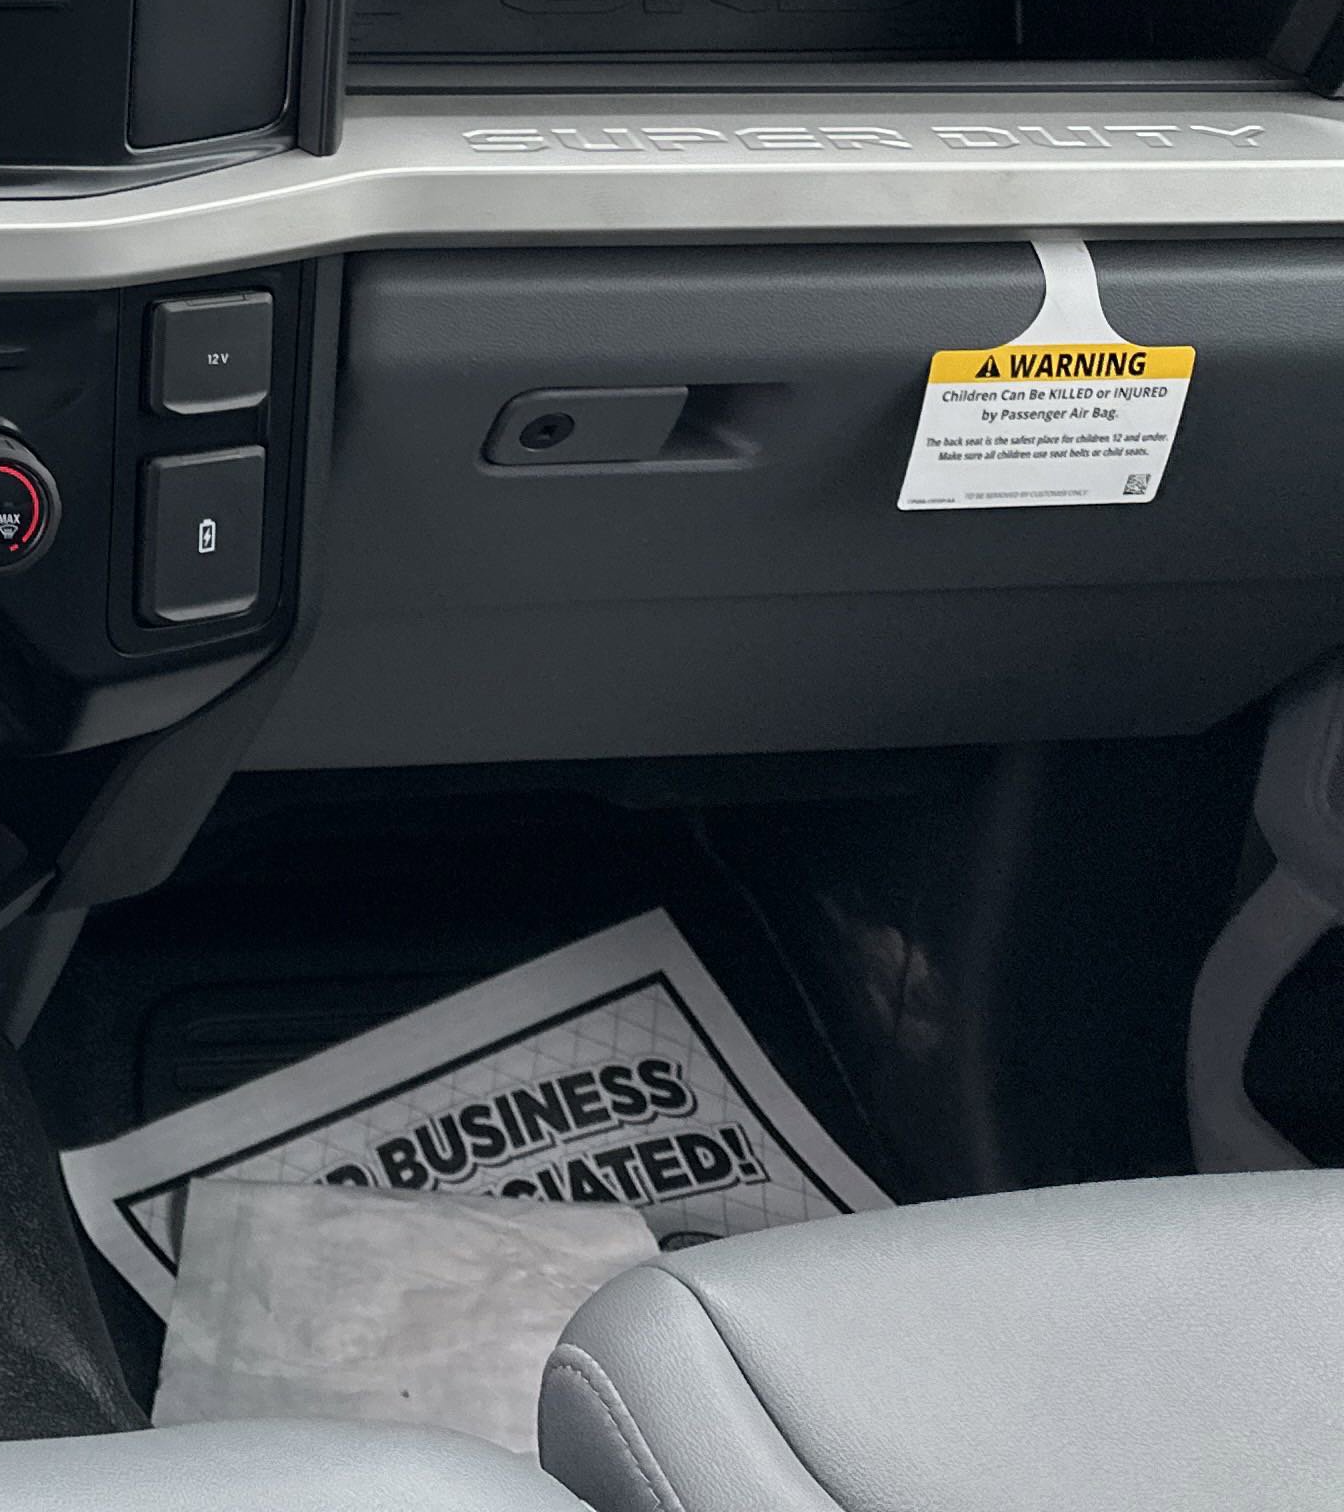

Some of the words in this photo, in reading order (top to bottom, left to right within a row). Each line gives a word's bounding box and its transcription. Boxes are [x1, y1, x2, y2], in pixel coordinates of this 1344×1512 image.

[462, 128, 912, 154] SUPER
[931, 125, 1267, 150] DUTY
[1010, 351, 1148, 378] WARNING
[942, 390, 997, 402] Children
[1001, 389, 1025, 401] Can
[1029, 388, 1046, 400] Be
[1049, 388, 1093, 400] KILLED
[1096, 389, 1111, 399] or
[1114, 386, 1168, 400] INJURED
[981, 409, 998, 423] by
[1001, 408, 1067, 423] Passenger
[1069, 407, 1089, 419] Air
[1092, 407, 1118, 421] Bag.
[927, 437, 941, 447] The
[943, 436, 963, 446] back
[965, 437, 983, 446] seat
[994, 436, 1008, 446] the
[1010, 435, 1035, 445] safest
[1037, 434, 1059, 446] place
[1061, 434, 1074, 444] for
[1076, 433, 1110, 443] children
[1124, 432, 1141, 442] and
[938, 451, 962, 461] Make
[963, 452, 983, 461] sure
[984, 450, 996, 460] all
[997, 450, 1031, 460] children
[1032, 451, 1048, 459] use
[1050, 449, 1068, 458] seat
[1069, 448, 1090, 457] belts
[1102, 447, 1124, 456] child
[374, 1059, 692, 1190] BUSINESS
